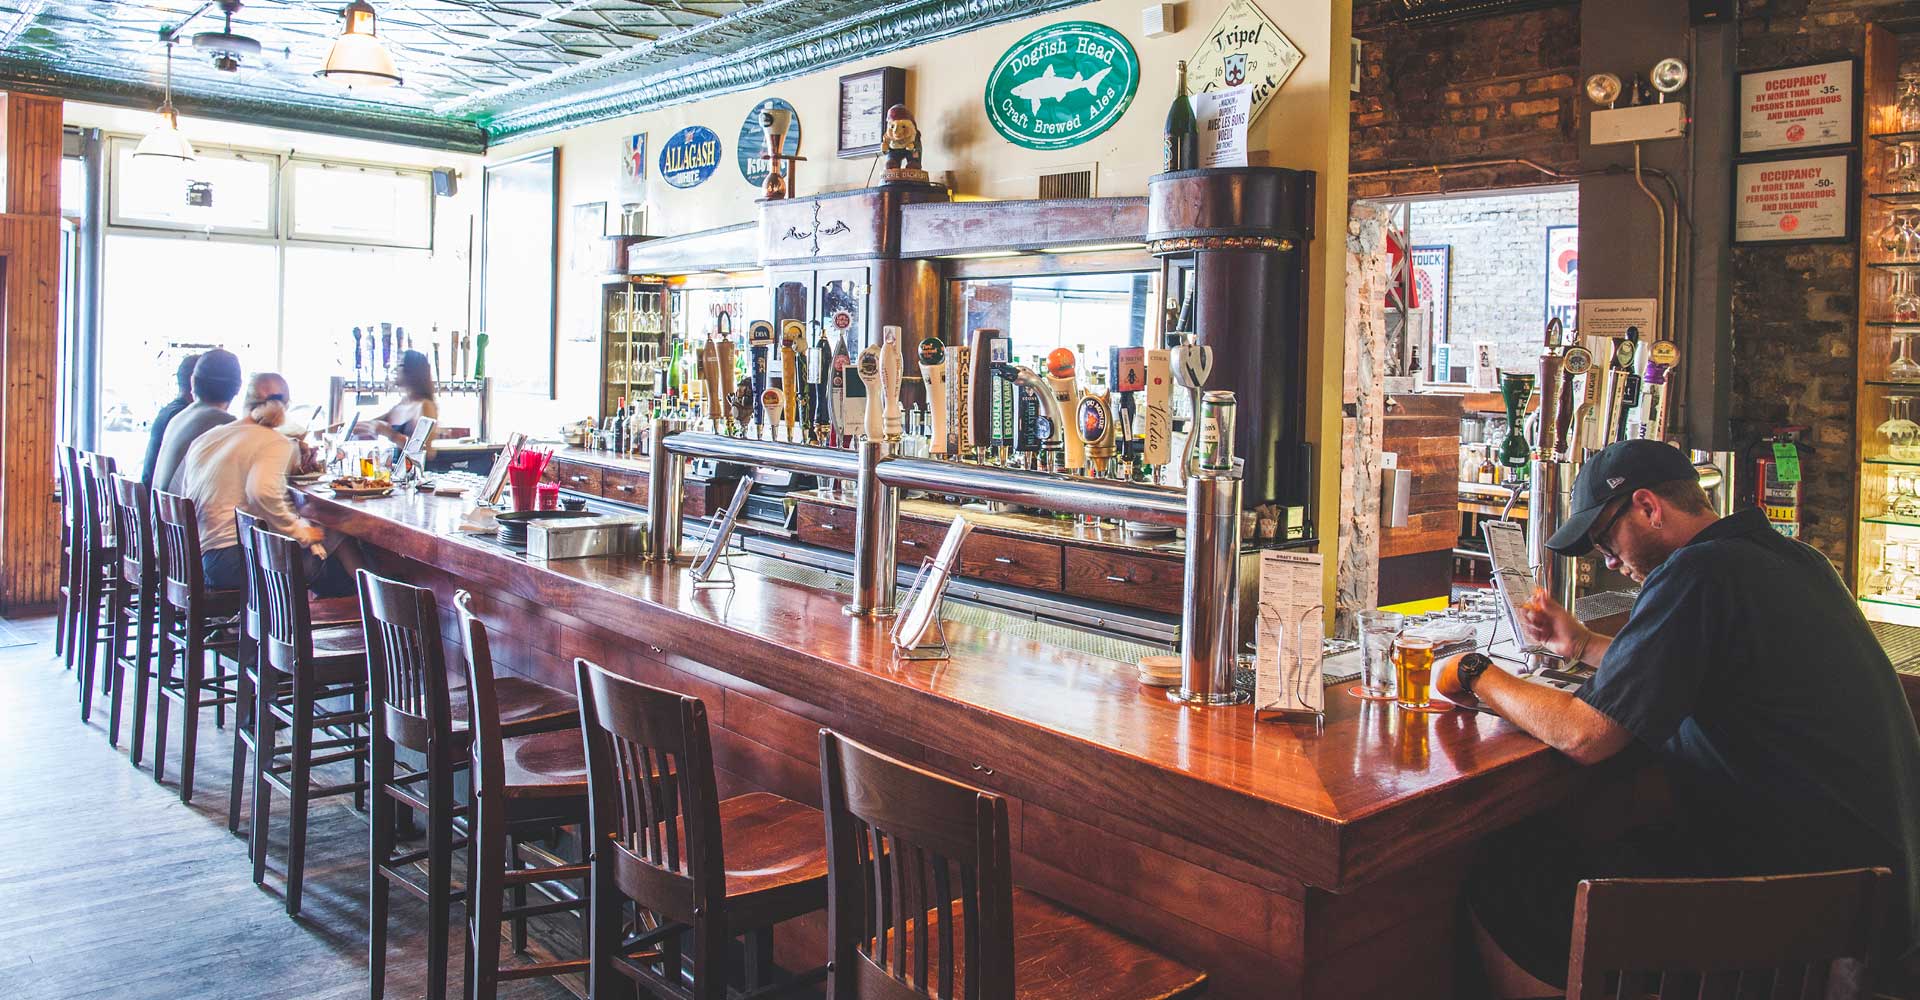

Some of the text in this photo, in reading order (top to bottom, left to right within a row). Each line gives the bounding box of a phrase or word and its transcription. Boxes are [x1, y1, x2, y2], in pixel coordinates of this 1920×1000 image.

[1212, 22, 1264, 61] Tripel
[1010, 36, 1115, 76] Dogfish Head
[1214, 66, 1222, 77] 16
[1248, 61, 1258, 71] 79
[1765, 74, 1827, 92] OCCUPANCY
[1820, 86, 1840, 94] -35-
[1756, 89, 1810, 102] BY MORE THAN
[1002, 88, 1116, 134] Craft Brewed Ales
[1751, 95, 1842, 112] PERSONS IS DANGEROUS
[1767, 107, 1824, 120] AND UNLAWFUL
[1208, 113, 1246, 131] AVEC LES BONS
[664, 141, 716, 173] ALLAGASH
[676, 170, 700, 185] WHITE
[1760, 168, 1822, 182] OCCUPANCY
[1751, 182, 1804, 193] BY MORE THAN
[1814, 179, 1834, 188] -50-
[1746, 188, 1836, 203] PERSONS IS DANGEROUS
[1762, 203, 1777, 212] AND
[1778, 201, 1818, 211] UNLAWFUL
[1148, 401, 1166, 452] Virtue
